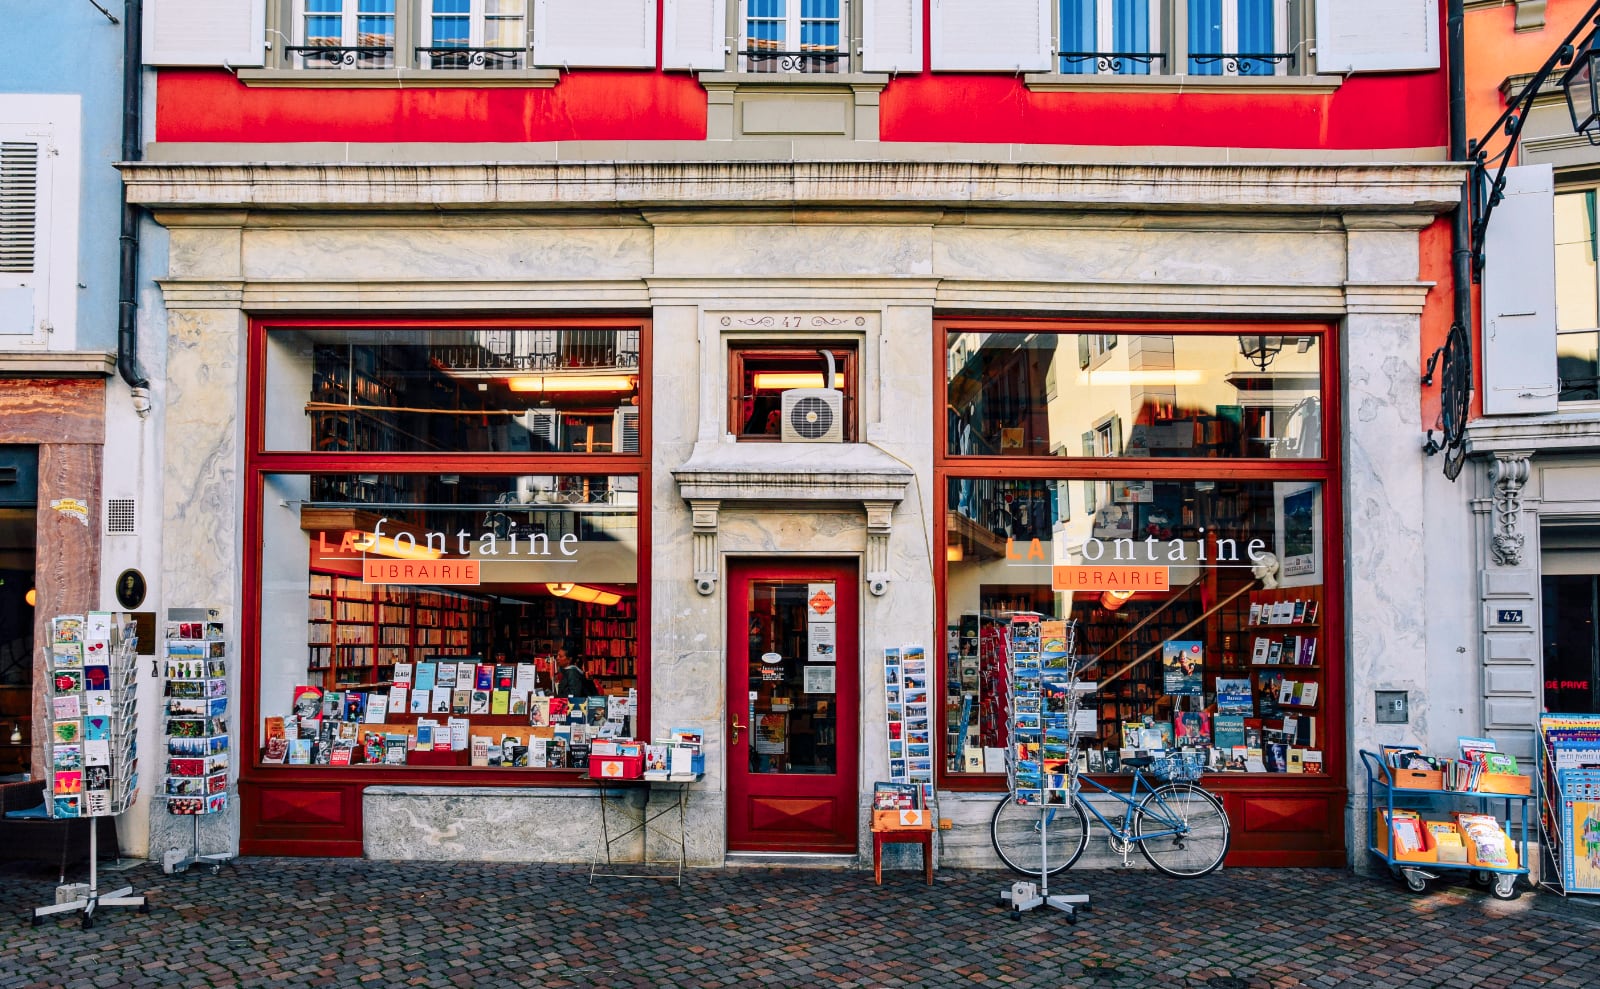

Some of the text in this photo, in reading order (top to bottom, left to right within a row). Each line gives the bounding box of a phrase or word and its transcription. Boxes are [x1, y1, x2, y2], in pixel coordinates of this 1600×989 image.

[782, 316, 802, 328] 47
[319, 531, 357, 553] LA
[374, 517, 578, 556] fontaine
[1007, 526, 1266, 561] LA fontaine
[370, 565, 474, 578] LIBRAIRIE
[1058, 571, 1163, 585] LIBRAIRIE
